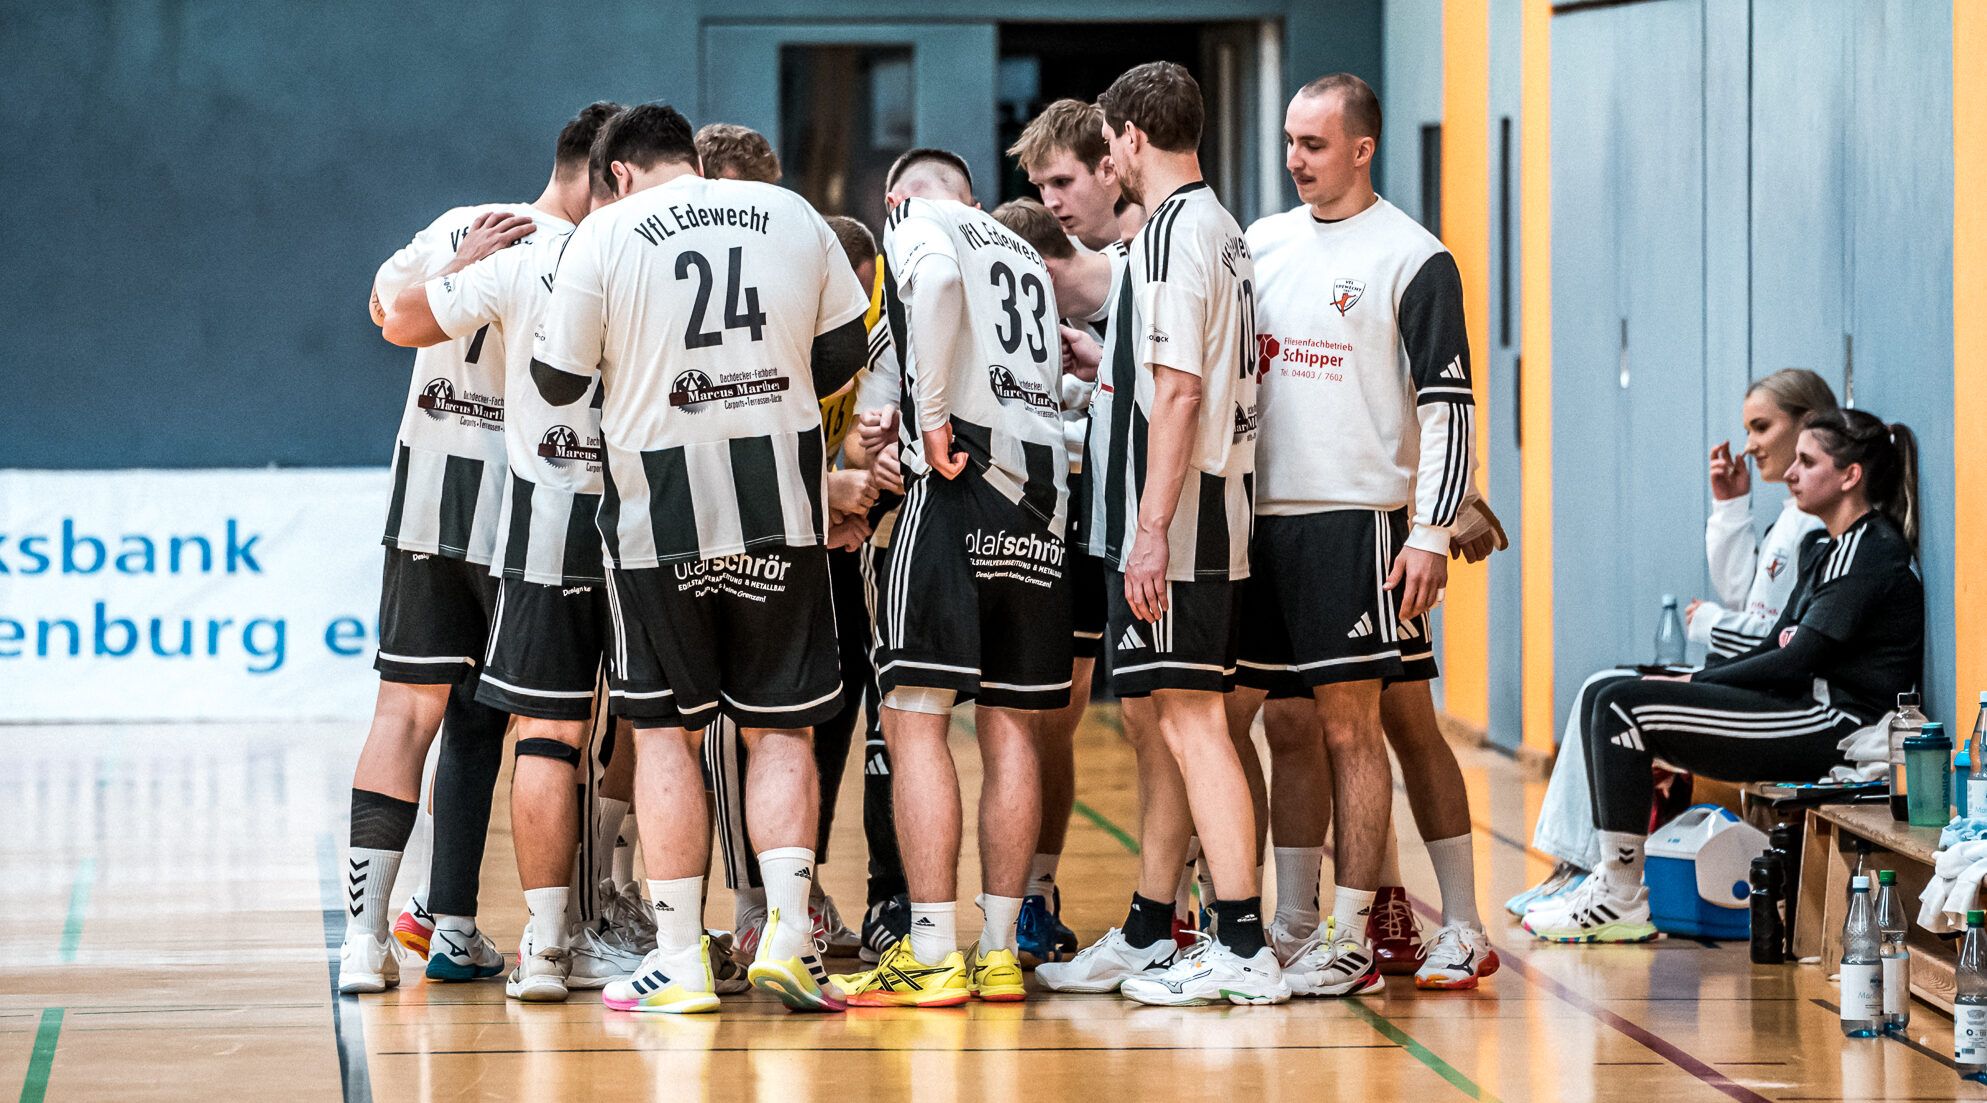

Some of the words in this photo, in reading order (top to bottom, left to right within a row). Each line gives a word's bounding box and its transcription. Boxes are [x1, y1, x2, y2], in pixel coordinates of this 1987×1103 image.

[634, 214, 676, 246] VfL
[669, 203, 770, 235] Edewecht
[674, 246, 767, 350] 24
[990, 261, 1048, 363] 33
[1237, 279, 1256, 380] 10
[1284, 337, 1353, 352] Fliesenfachbetrieb
[1282, 348, 1344, 368] Schipper
[1291, 369, 1316, 379] 04403
[1324, 373, 1343, 382] 7602
[687, 388, 734, 403] Marcus
[434, 397, 470, 414] Marcus
[554, 445, 598, 461] Marcus
[965, 528, 1066, 567] olafschrör
[750, 580, 786, 592] METALLBAU
